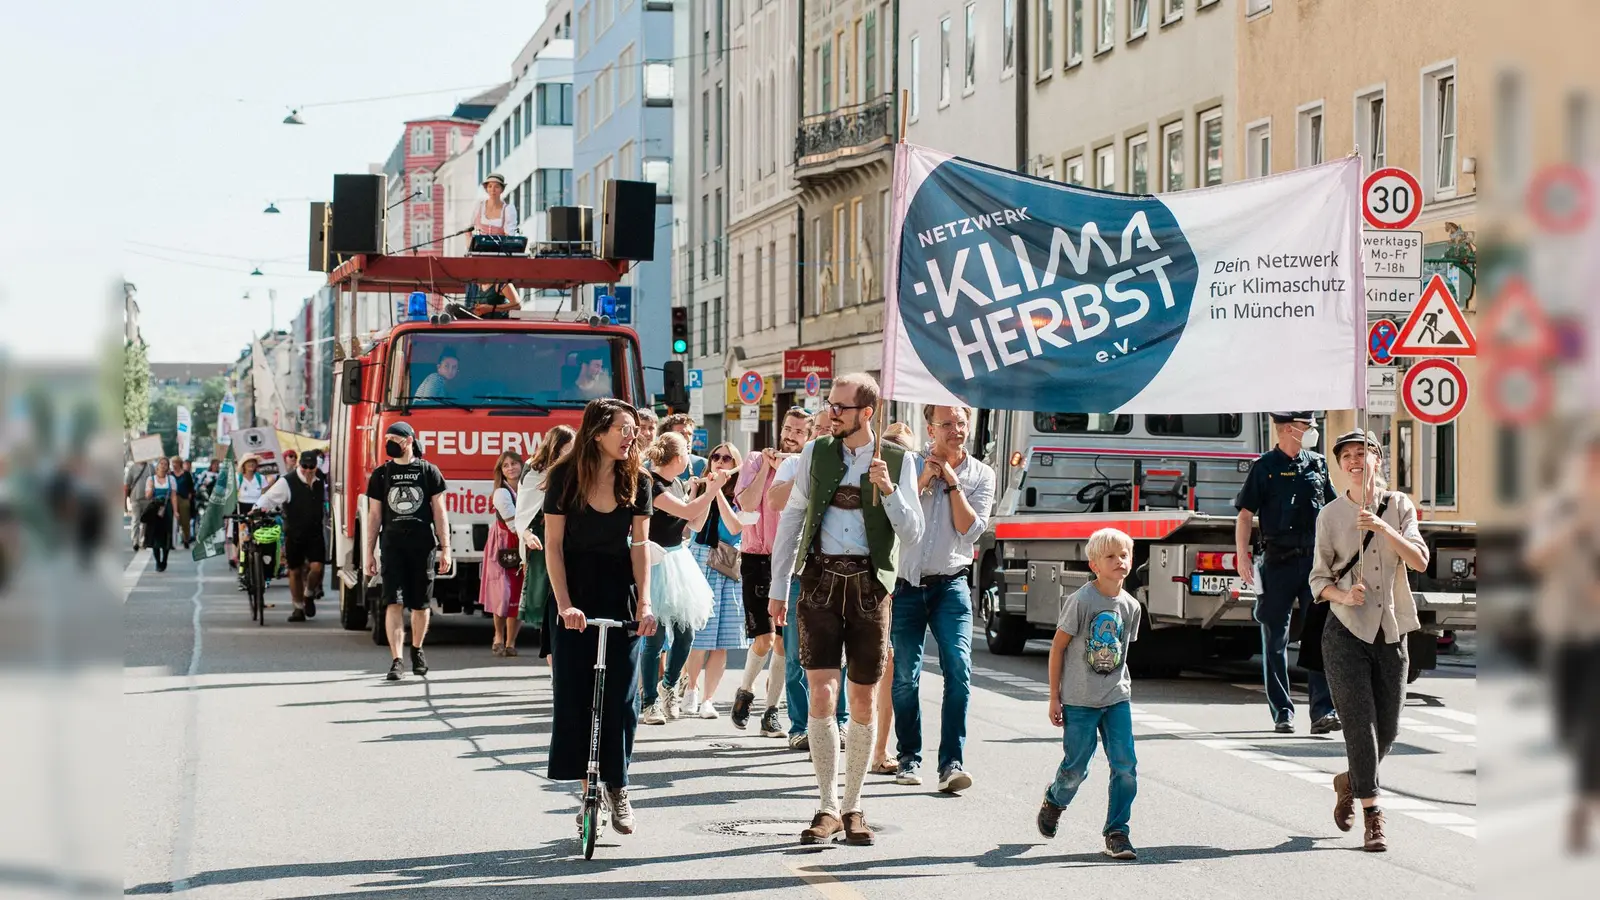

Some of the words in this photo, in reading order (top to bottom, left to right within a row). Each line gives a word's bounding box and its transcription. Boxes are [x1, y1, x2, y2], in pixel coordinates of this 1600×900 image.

[1373, 186, 1409, 214] 30
[917, 206, 1032, 249] NETZWERK
[1363, 236, 1418, 249] werktags
[1214, 258, 1250, 274] Dein
[1257, 251, 1339, 269] Netzwerk
[1371, 249, 1408, 259] Mo-Fr
[1374, 262, 1405, 273] 7-18h
[1209, 282, 1236, 298] für
[1243, 276, 1346, 294] Klimaschutz
[1366, 288, 1415, 302] Kinder
[948, 255, 1176, 380] HERBST
[1210, 305, 1227, 319] in
[1234, 301, 1315, 319] München
[1417, 377, 1455, 407] 30
[1202, 577, 1211, 590] M
[1240, 578, 1252, 591] 3
